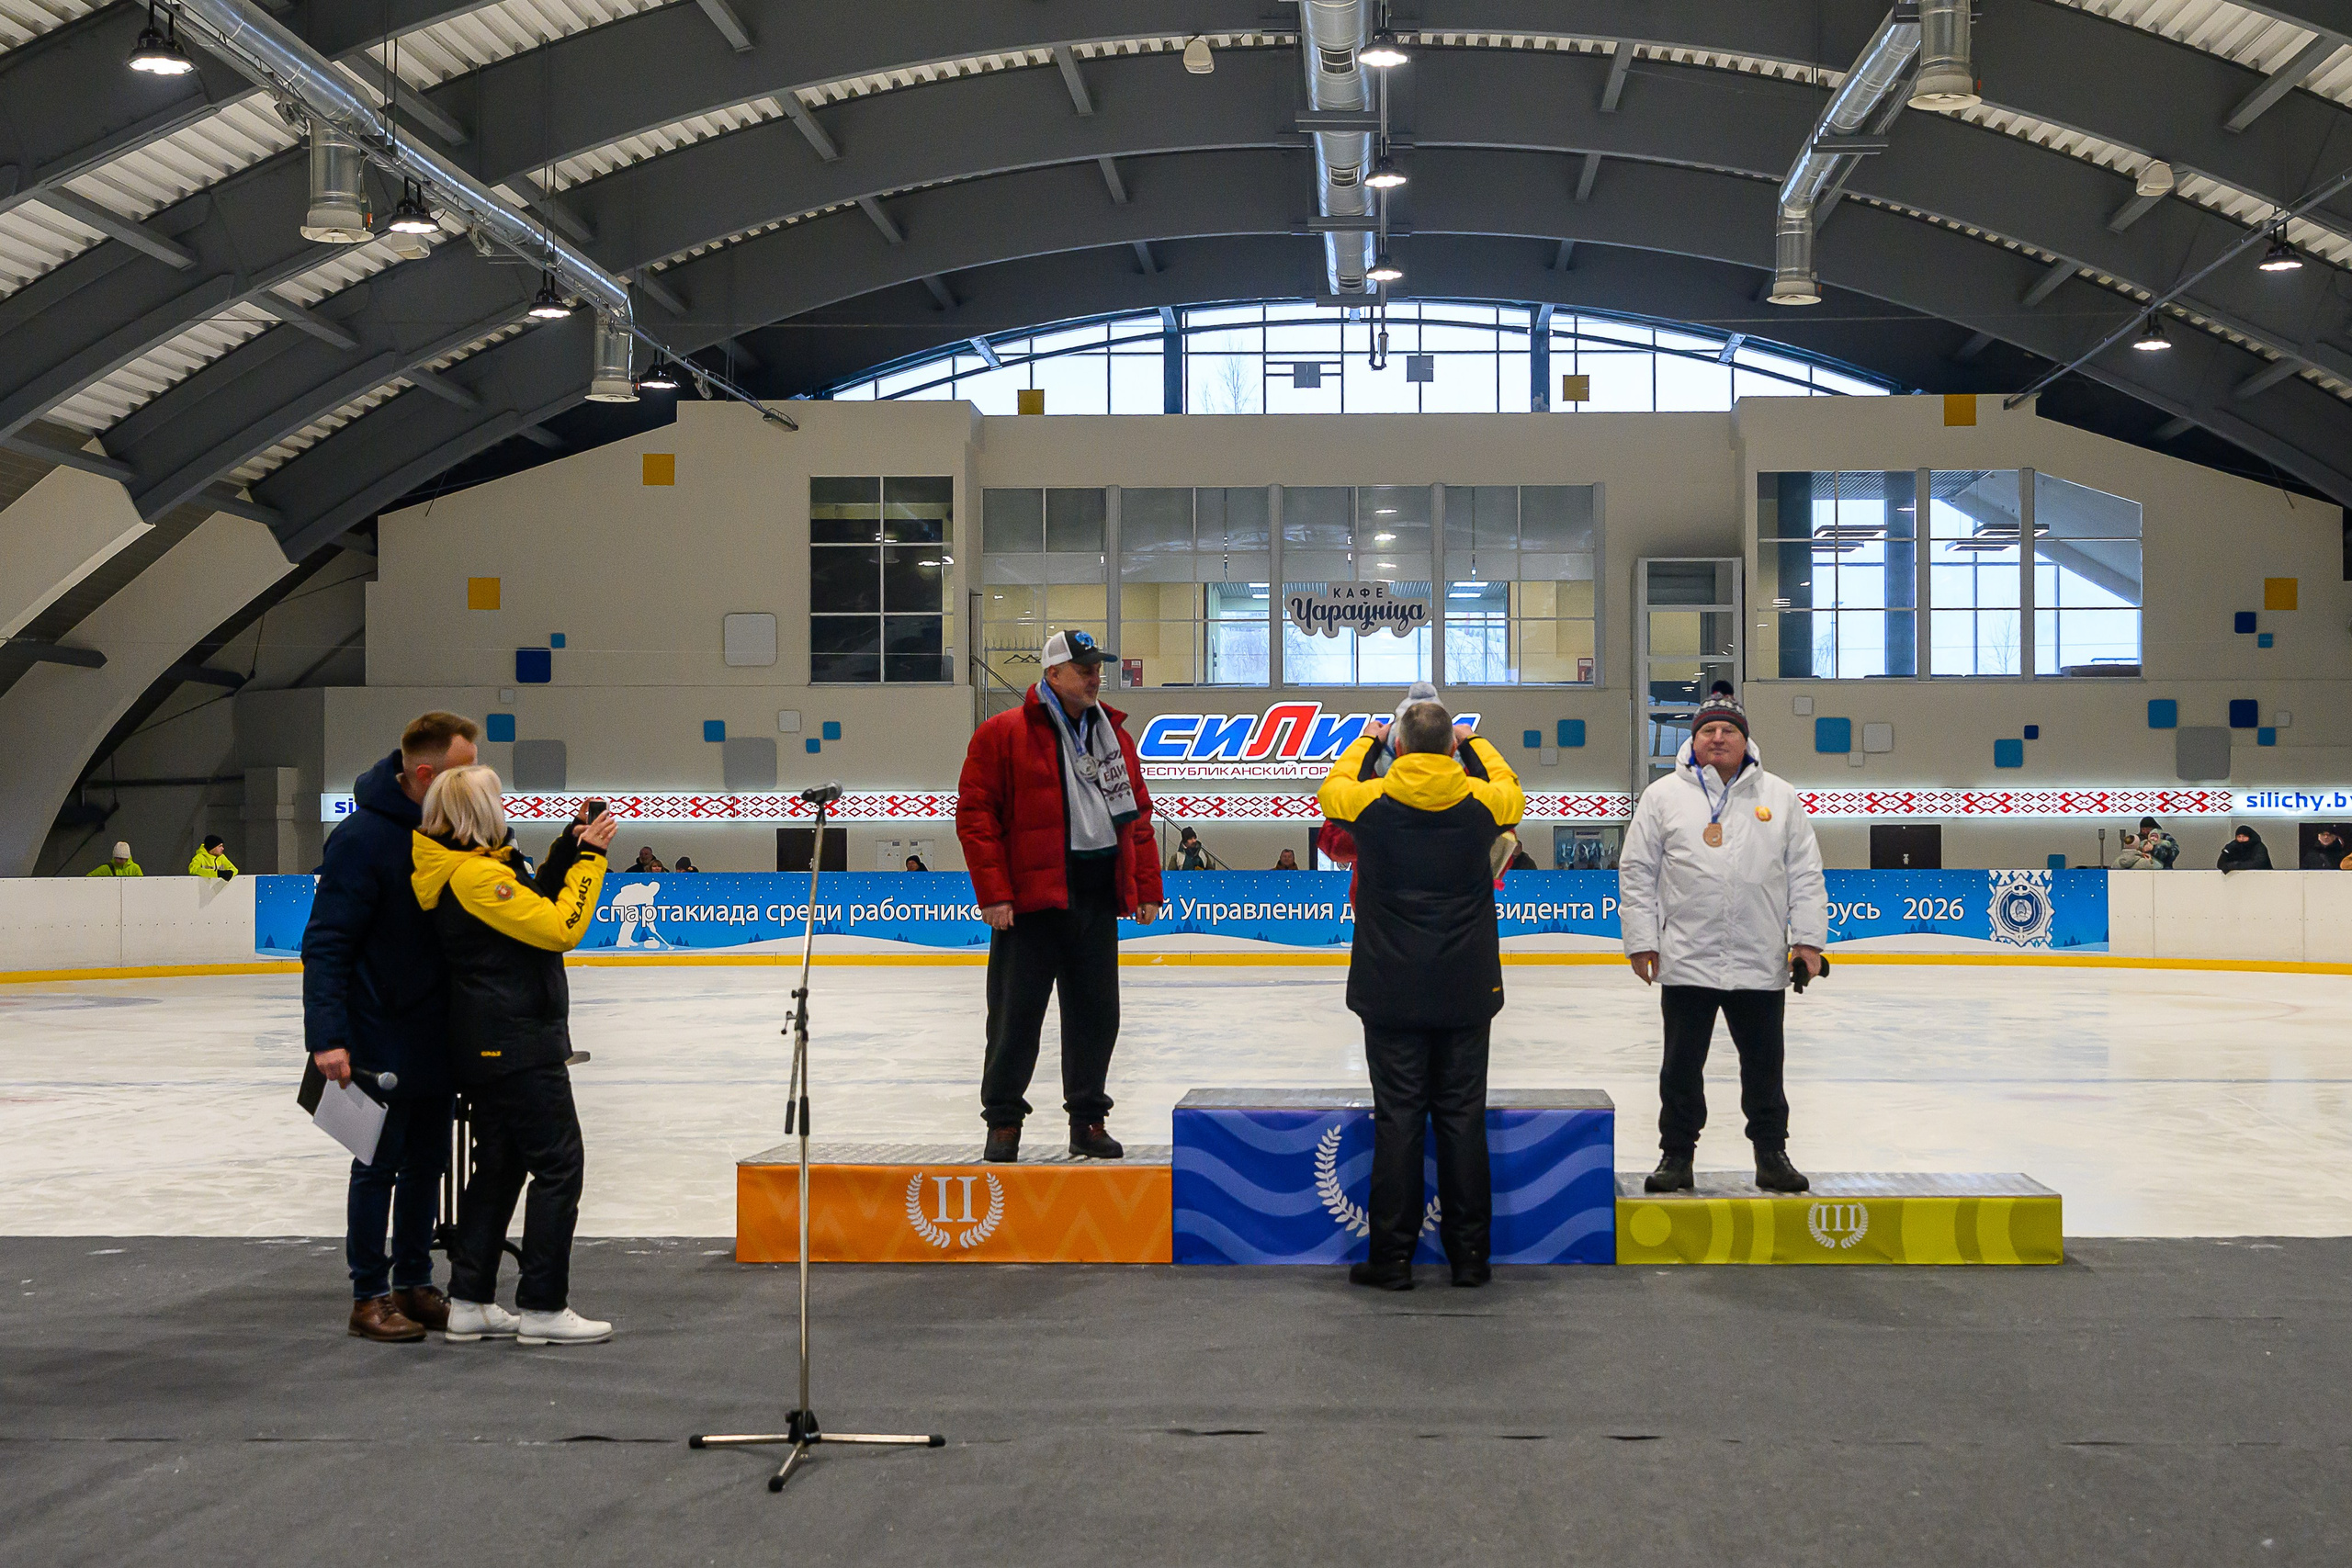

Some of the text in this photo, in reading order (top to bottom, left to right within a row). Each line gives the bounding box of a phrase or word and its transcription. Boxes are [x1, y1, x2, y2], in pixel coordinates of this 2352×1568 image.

[1333, 587, 1383, 598] КАФЕ
[1291, 597, 1426, 631] Чараўніца
[2246, 792, 2352, 811] silichy.b
[765, 904, 842, 927] среди
[850, 897, 982, 927] работнико
[1180, 897, 1334, 926] Управления
[1495, 902, 1594, 924] зидента
[1902, 897, 1964, 920] 2026
[931, 1176, 978, 1223] II
[1818, 1204, 1859, 1232] III
